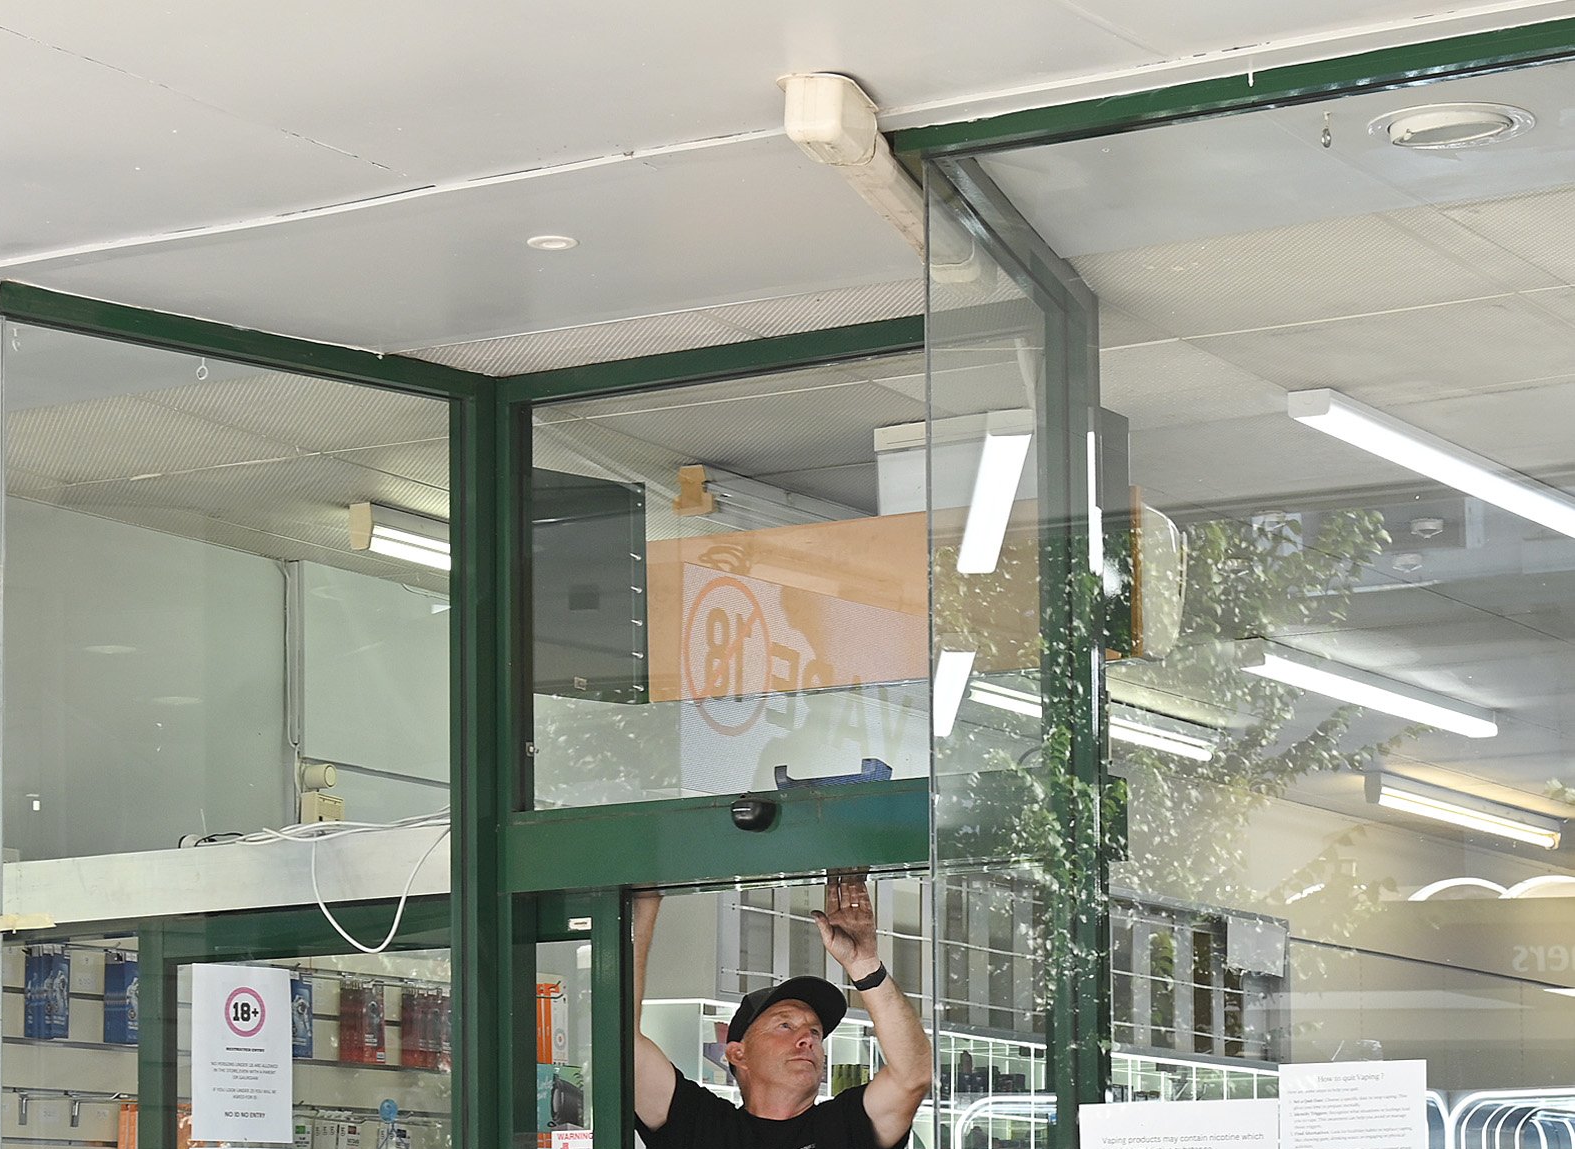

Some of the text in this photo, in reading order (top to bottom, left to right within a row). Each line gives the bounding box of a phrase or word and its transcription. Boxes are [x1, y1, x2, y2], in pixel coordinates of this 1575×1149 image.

[232, 1002, 259, 1022] 18+
[1102, 1132, 1264, 1146] Vaping products may contain nicotine which
